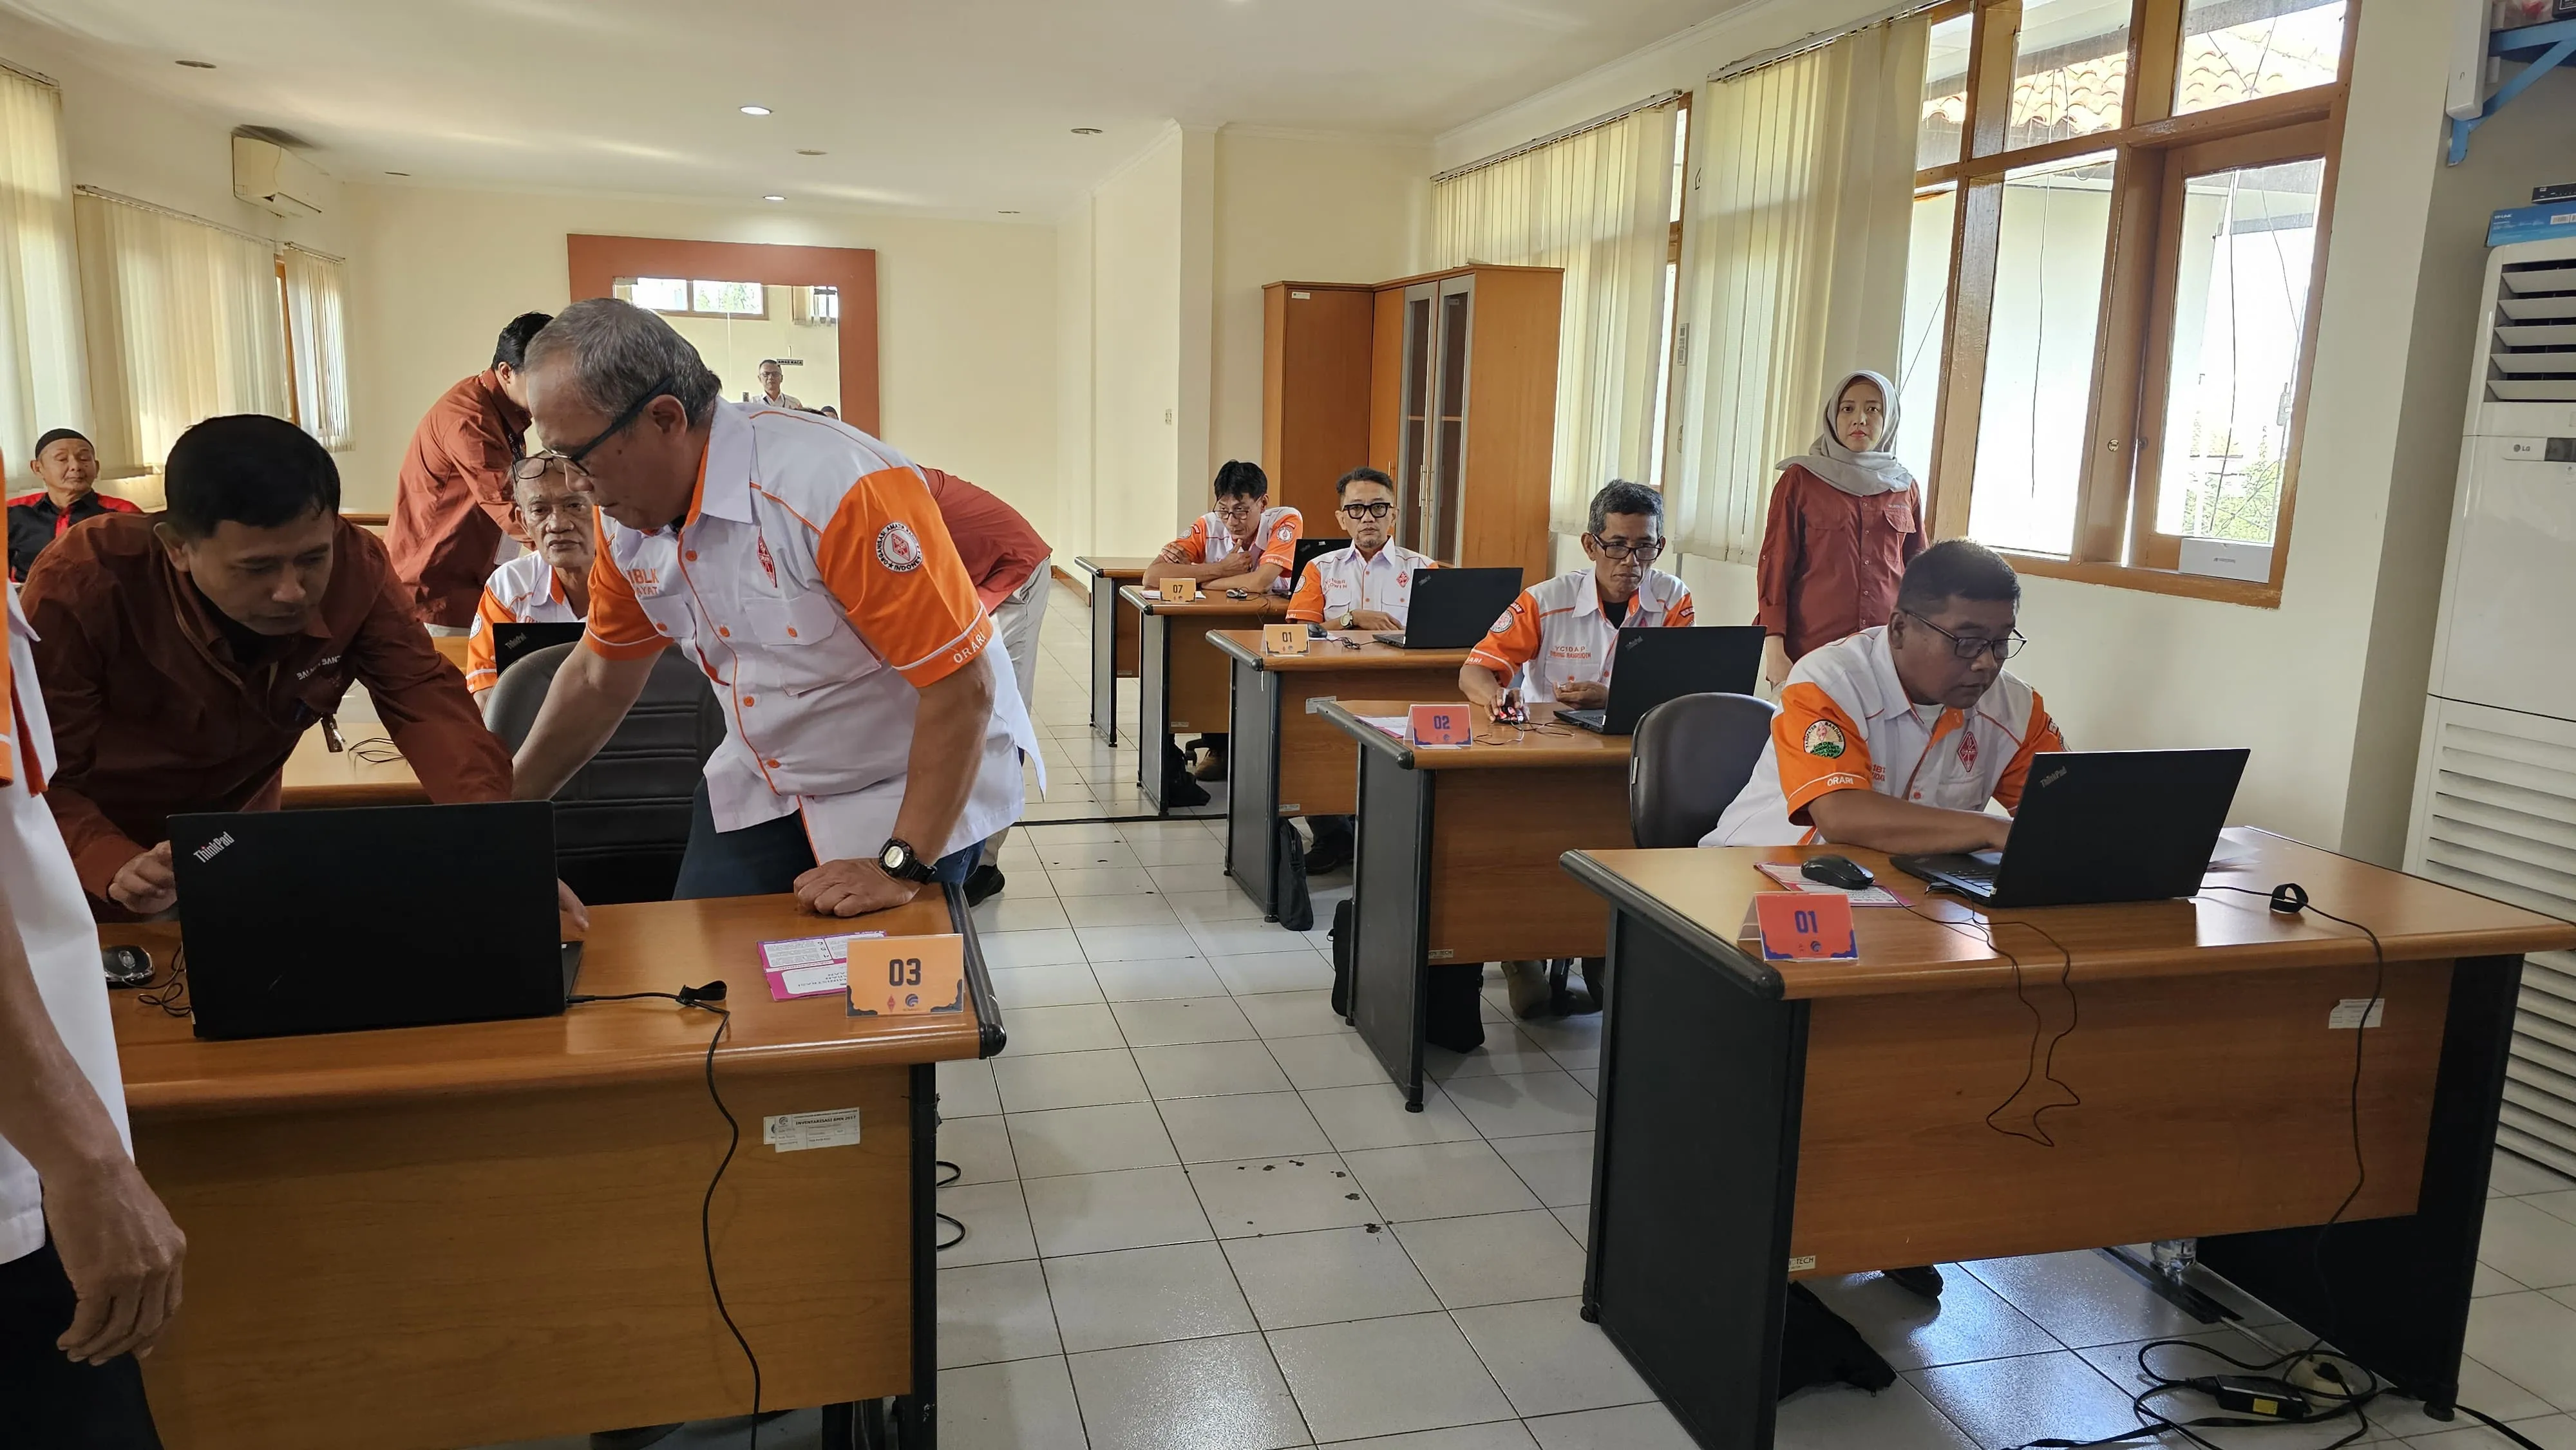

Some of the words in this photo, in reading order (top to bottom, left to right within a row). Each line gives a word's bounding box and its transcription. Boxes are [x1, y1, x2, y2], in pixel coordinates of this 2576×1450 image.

[1266, 558, 1283, 567] ORARI
[1173, 584, 1184, 594] 07
[1282, 631, 1293, 643] 01
[953, 631, 986, 663] ORARI
[1434, 715, 1450, 730] 02
[1827, 777, 1854, 787] ORARI
[193, 831, 234, 863] ThinkPad
[1795, 910, 1819, 934] 01
[889, 957, 922, 986] 03
[795, 1117, 833, 1126] INVENTARISASI
